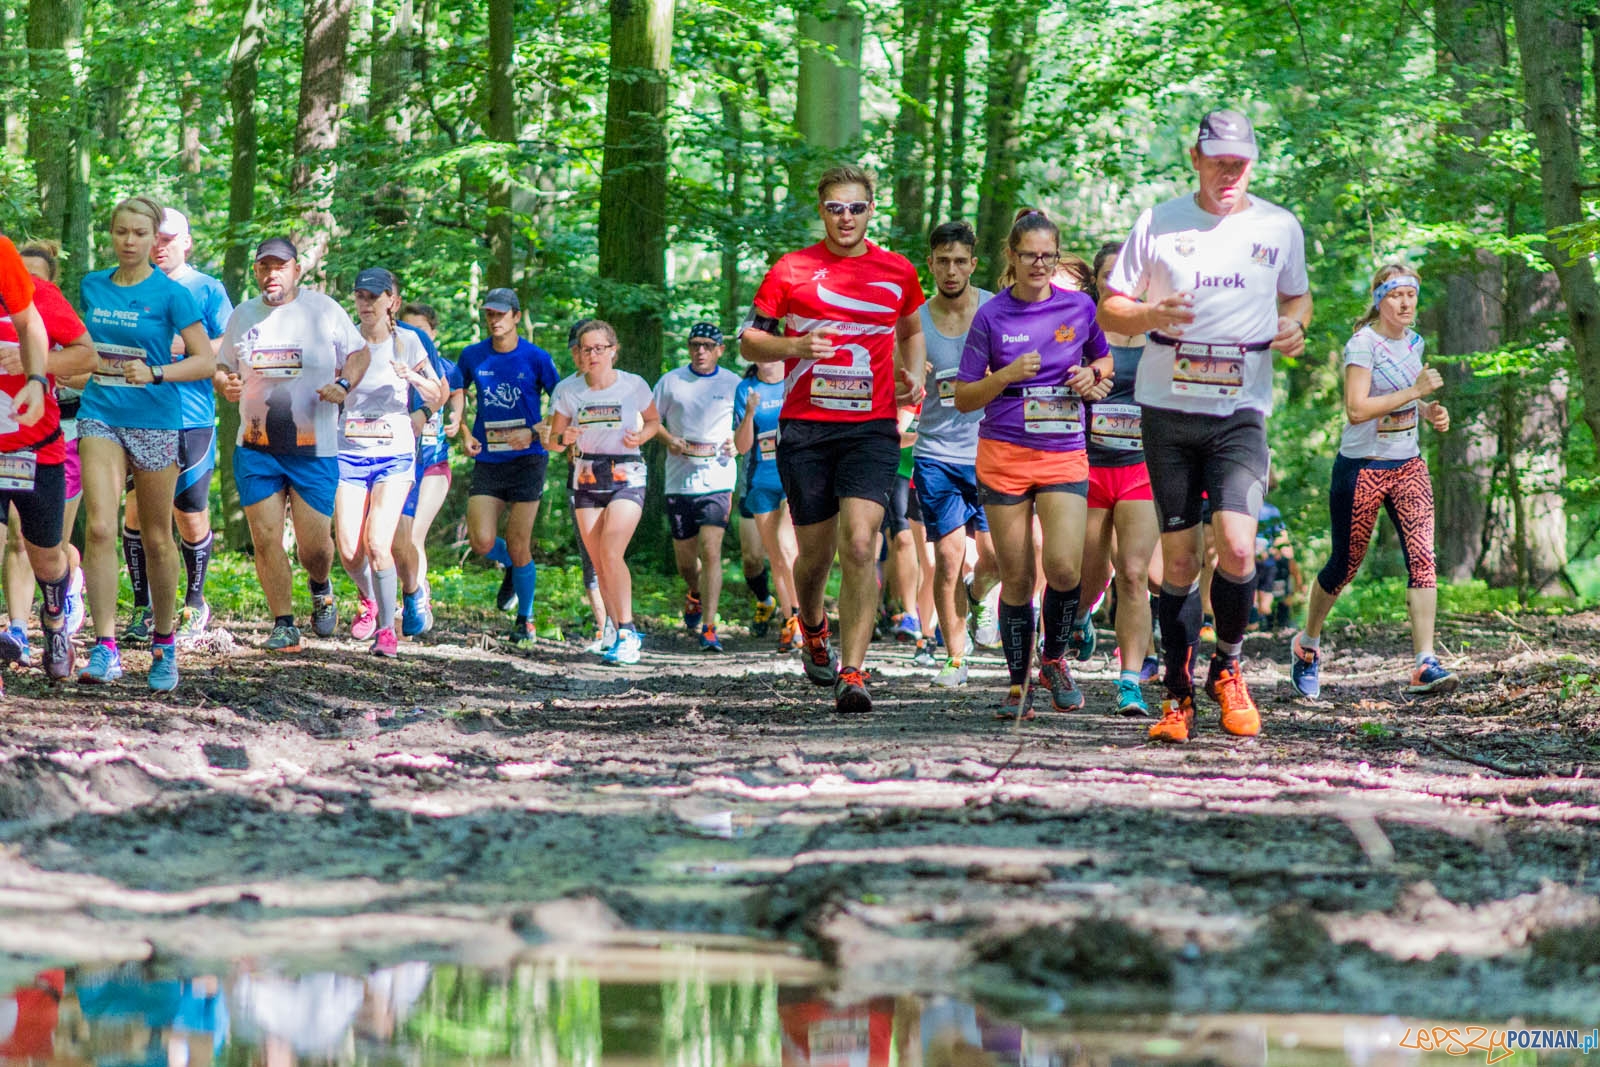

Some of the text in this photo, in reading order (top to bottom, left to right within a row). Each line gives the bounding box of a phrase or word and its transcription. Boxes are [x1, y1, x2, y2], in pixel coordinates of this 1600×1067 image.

[1194, 271, 1246, 290] Jarek
[1200, 358, 1217, 374] 31
[829, 379, 855, 391] 432
[1111, 416, 1135, 429] 317
